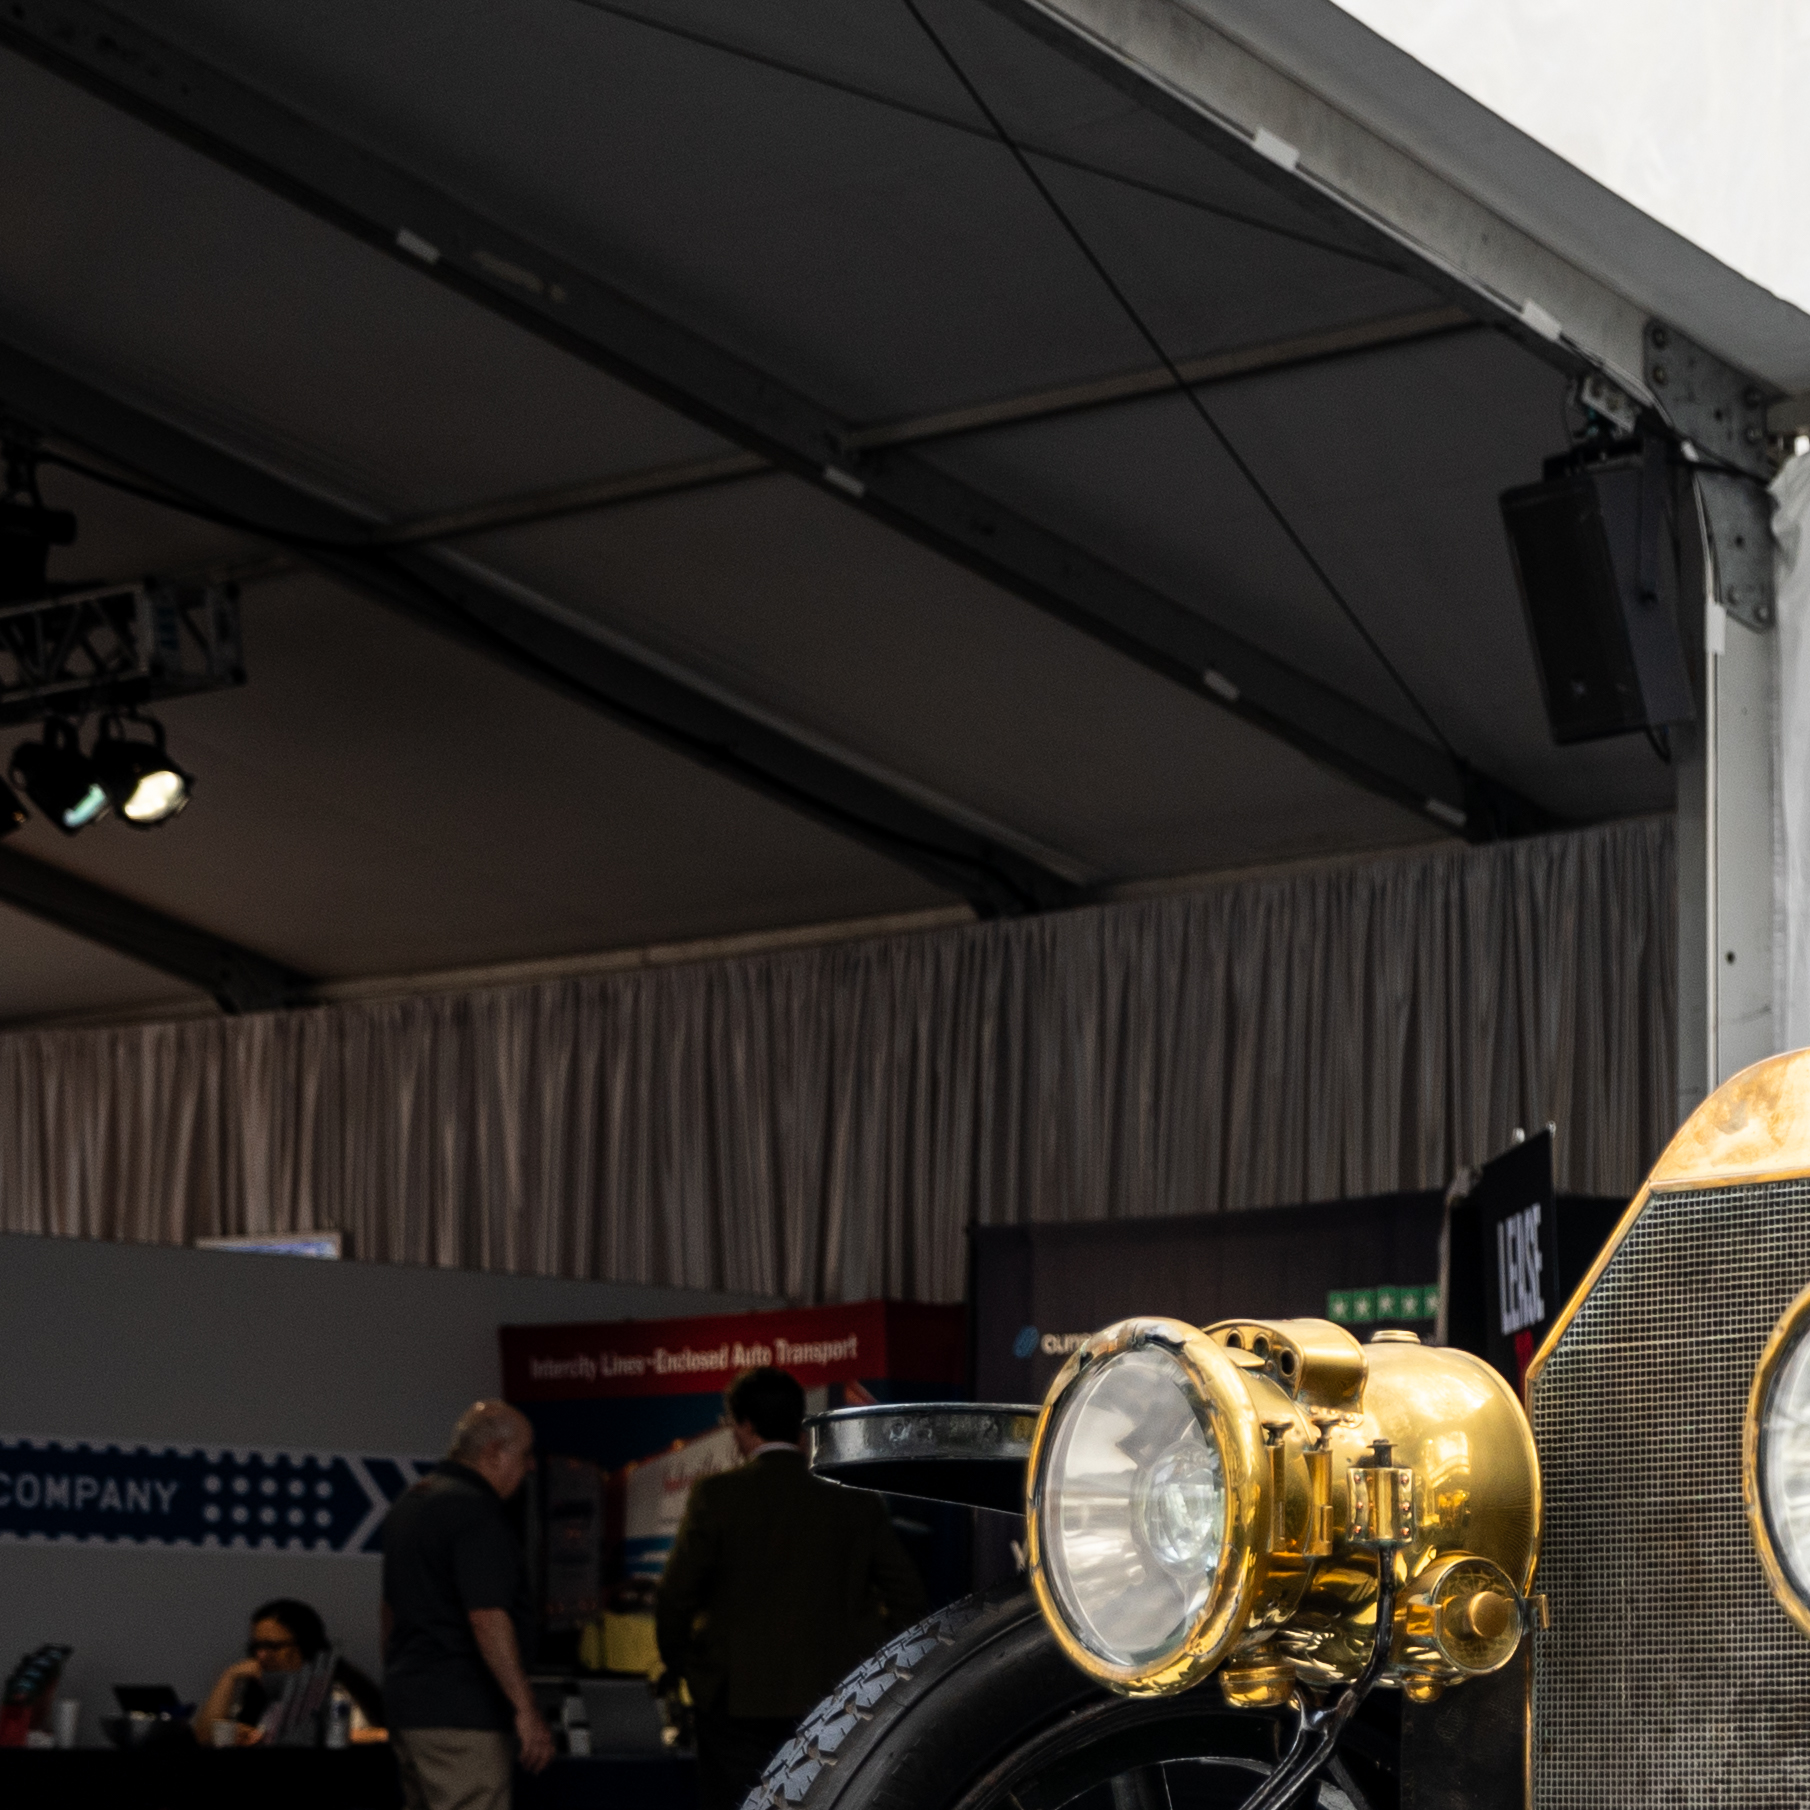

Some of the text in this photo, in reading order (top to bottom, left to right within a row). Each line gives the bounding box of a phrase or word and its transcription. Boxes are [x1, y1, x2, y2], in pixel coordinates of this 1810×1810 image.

[1497, 1202, 1545, 1336] LEASE
[733, 1340, 772, 1368] Auto
[773, 1331, 857, 1367] Transport
